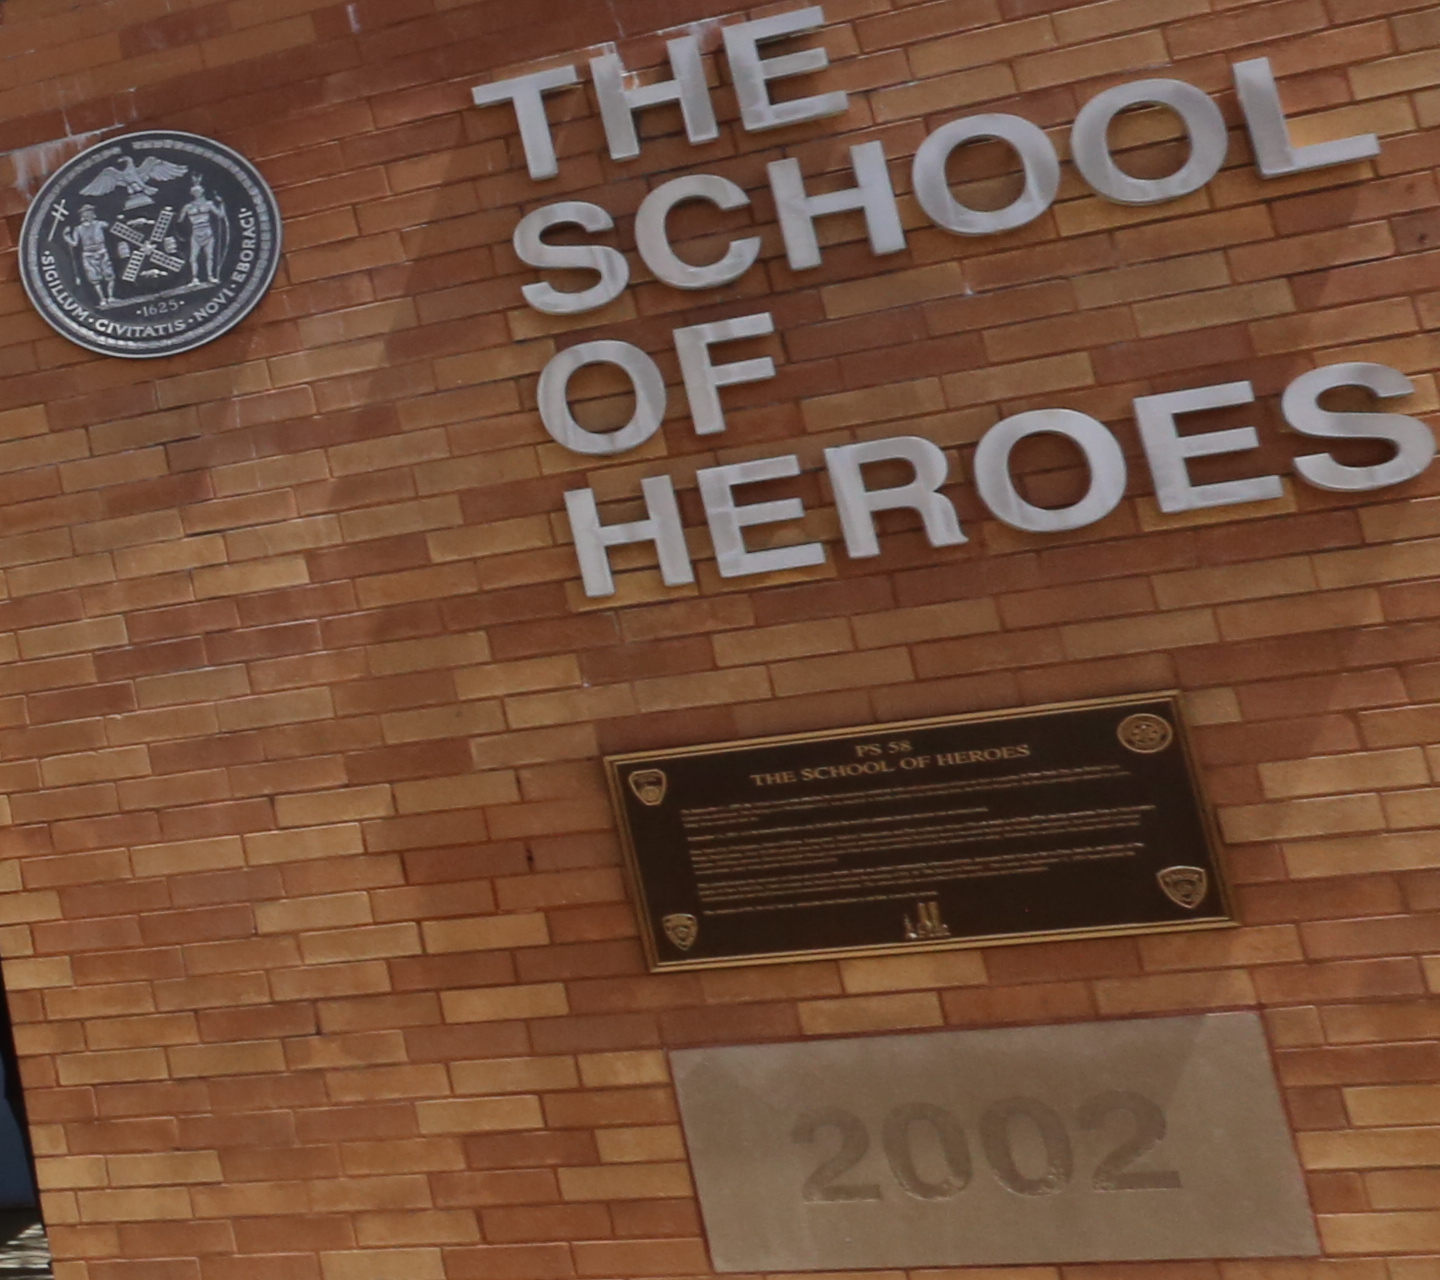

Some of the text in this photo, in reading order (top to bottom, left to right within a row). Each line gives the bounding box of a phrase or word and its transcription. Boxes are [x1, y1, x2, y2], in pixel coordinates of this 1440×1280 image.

[471, 6, 849, 181] THE
[512, 56, 1381, 314] SCHOOL
[41, 210, 257, 338] SIGILLUM CIVITATIS NOVI EBORACI
[536, 312, 776, 455] OF
[563, 361, 1437, 597] HEROES
[750, 744, 1031, 787] THE SCHOOL OF HEROES
[854, 740, 913, 757] PS 58
[789, 1089, 1183, 1204] 2002
